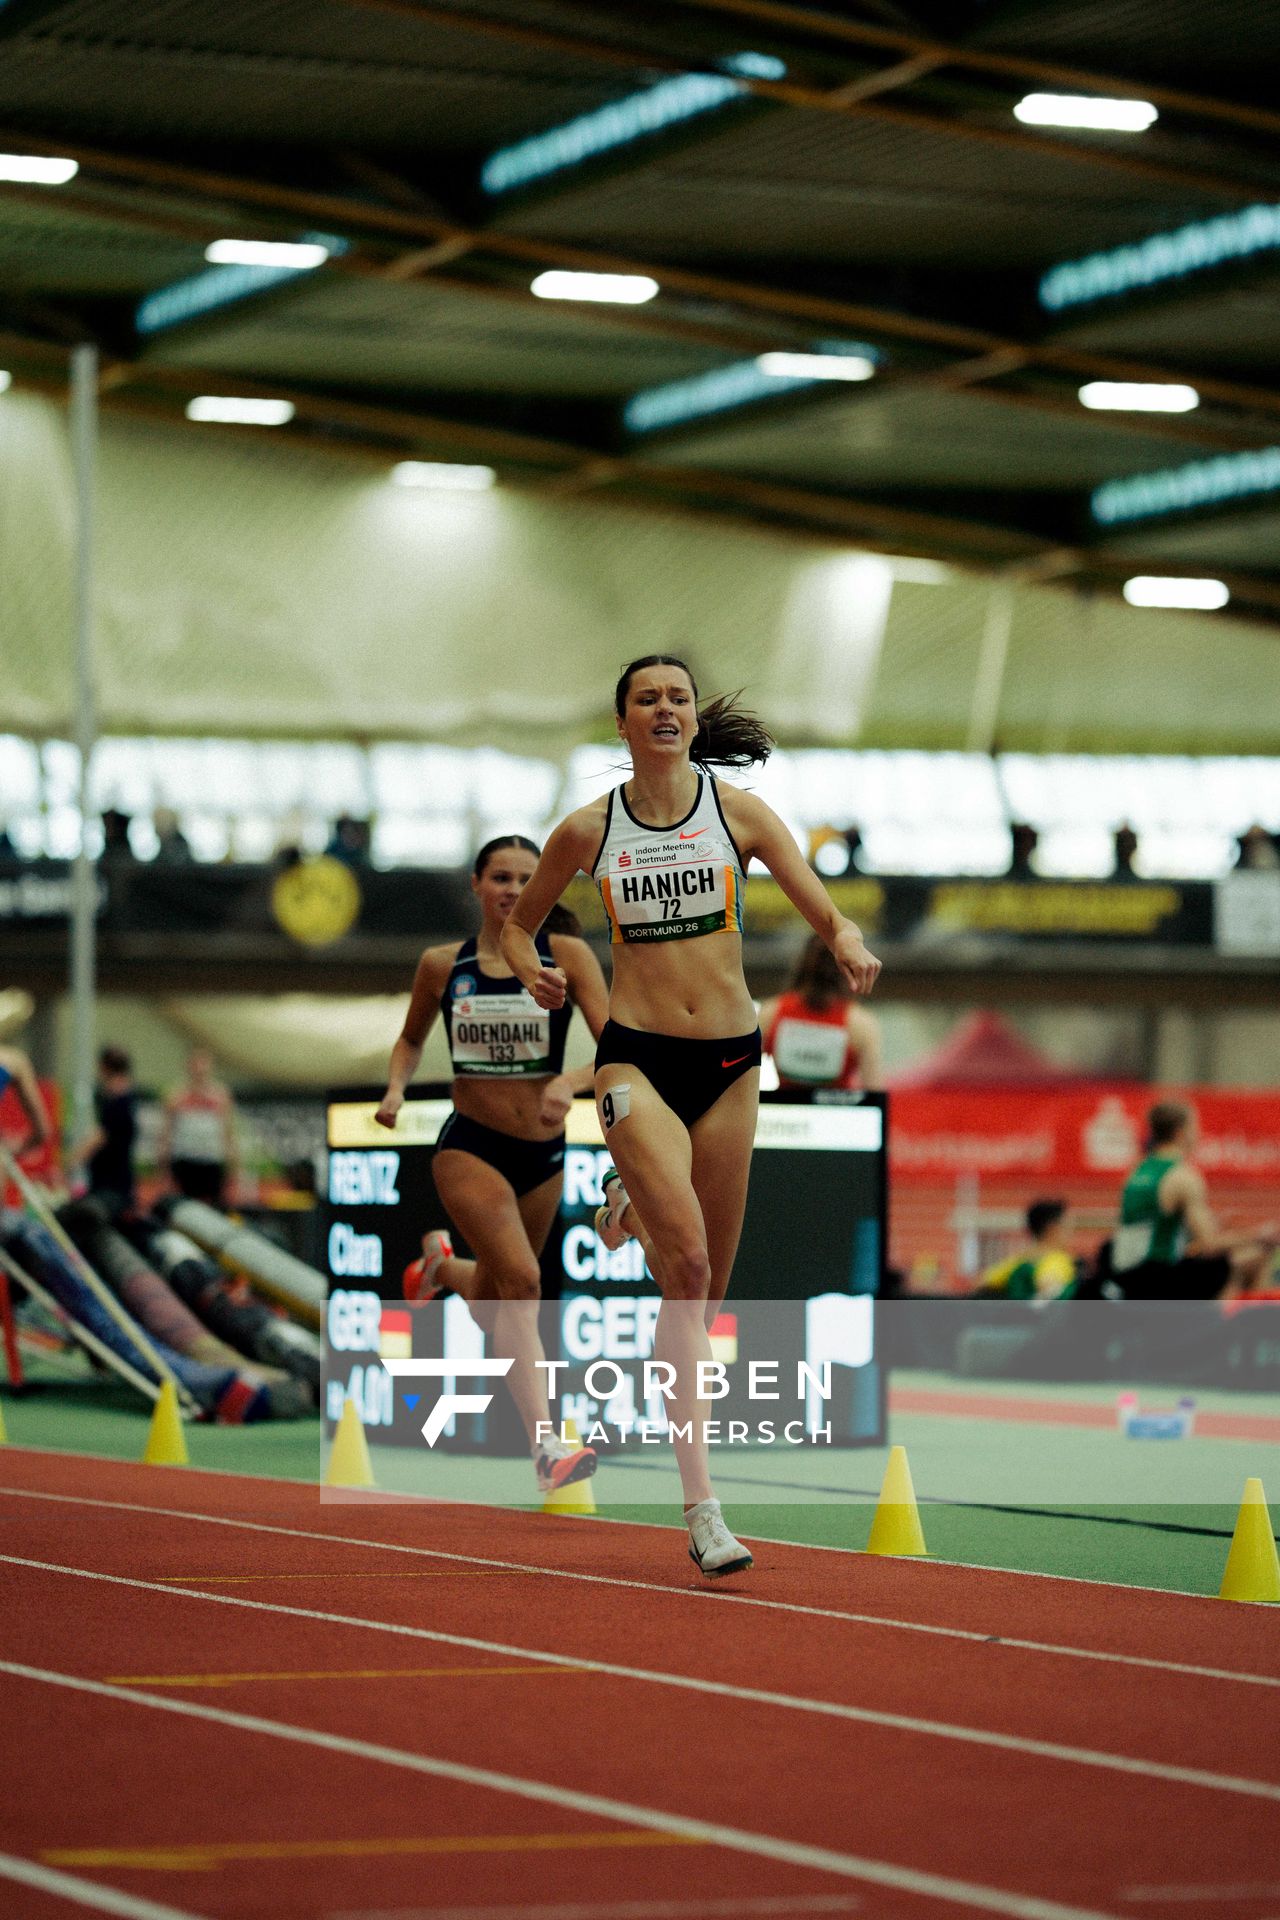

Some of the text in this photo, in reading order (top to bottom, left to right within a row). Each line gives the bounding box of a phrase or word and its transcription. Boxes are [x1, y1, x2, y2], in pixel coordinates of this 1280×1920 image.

[635, 842, 695, 855] Indoor Meeting
[635, 853, 677, 865] Dortmund
[622, 867, 715, 903] HANICH
[659, 898, 682, 920] 72
[628, 922, 698, 938] DORTMUND 26
[457, 1022, 543, 1044] ODENDAHL
[488, 1045, 515, 1062] 133
[602, 1092, 615, 1128] 9
